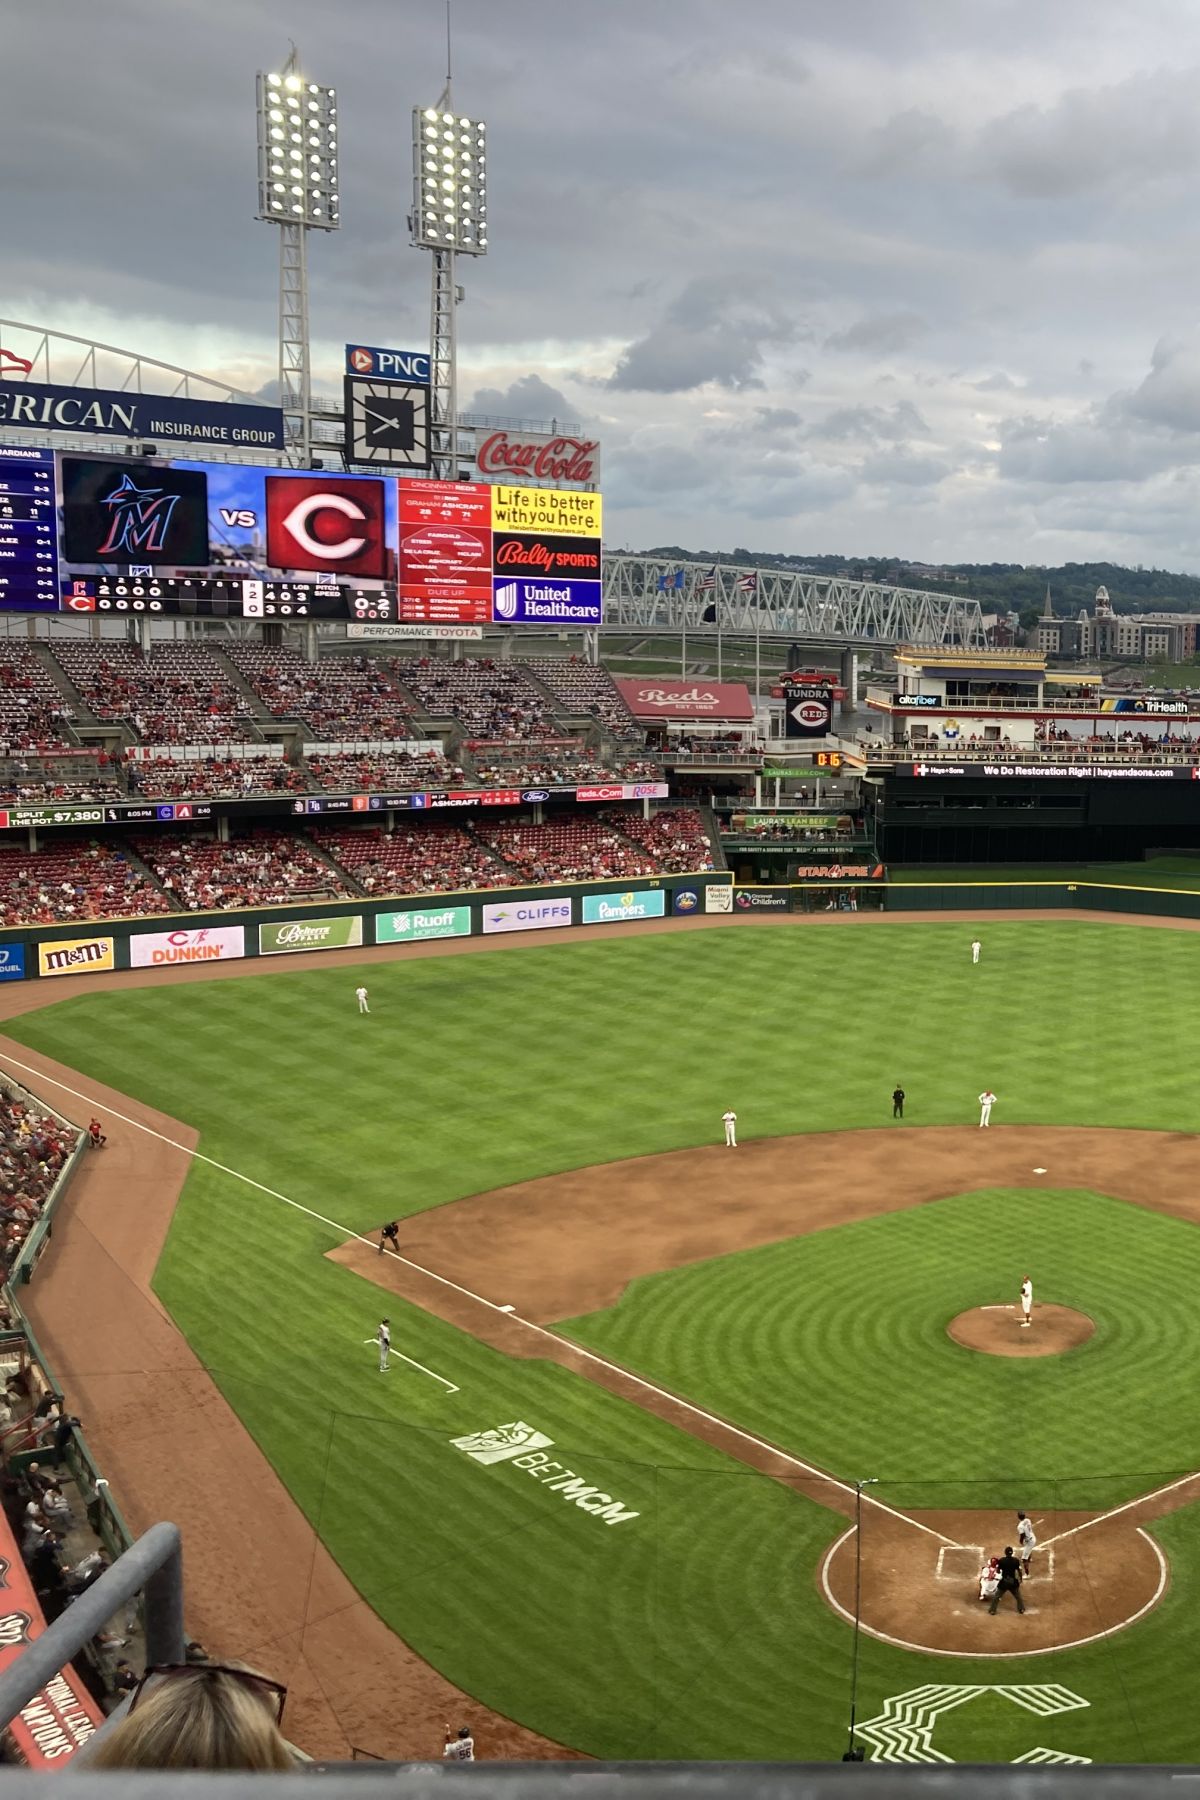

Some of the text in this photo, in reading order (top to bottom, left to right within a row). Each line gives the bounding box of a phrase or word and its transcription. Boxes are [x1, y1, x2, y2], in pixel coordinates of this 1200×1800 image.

[376, 352, 428, 378] PNC
[150, 420, 228, 440] INSURANCE
[232, 428, 276, 443] GROUP
[0, 449, 41, 458] ARDIANS
[442, 502, 484, 511] ASHCRAFT
[497, 487, 594, 511] Life is better
[221, 508, 255, 527] VS
[495, 508, 599, 528] with you here.
[497, 541, 598, 572] Bally SPORTS
[99, 585, 110, 595] 2
[115, 586, 128, 596] 0
[132, 586, 145, 596] 0
[149, 587, 161, 597] 0
[265, 592, 276, 601] 4
[280, 592, 291, 601] 0
[297, 592, 307, 601] 3
[427, 588, 449, 596] DUE
[524, 585, 571, 601] United
[99, 600, 307, 615] 0 0 0 0 0 3 0 4
[524, 601, 599, 617] Healthcare
[363, 626, 479, 638] PERFORMANCE TOYOTA
[637, 689, 720, 706] Reds
[787, 689, 829, 699] TUNDRA
[899, 695, 937, 706] altafiber
[801, 710, 828, 718] REDS
[1145, 701, 1188, 713] TriHealth
[984, 766, 999, 775] We
[1000, 766, 1014, 775] Do
[1015, 766, 1066, 776] Restoration
[1068, 767, 1092, 777] Right
[1097, 766, 1173, 777] haysandsons.com
[526, 792, 546, 801] Ford
[633, 785, 657, 797] ROSE
[431, 799, 479, 808] ASHCRAFT
[11, 818, 31, 826] THE
[53, 811, 101, 822] $7,380
[516, 906, 570, 921] CLIFFS
[599, 902, 645, 919] Pampers
[413, 911, 456, 928] Ruoff
[276, 924, 331, 945] Belterra
[300, 933, 326, 941] PARK
[413, 926, 455, 937] MORTGAGE
[152, 944, 223, 963] DUNKIN'
[511, 1452, 641, 1526] BETMGM
[46, 1671, 79, 1714] TIONAL
[20, 1696, 73, 1760] AMPIONS
